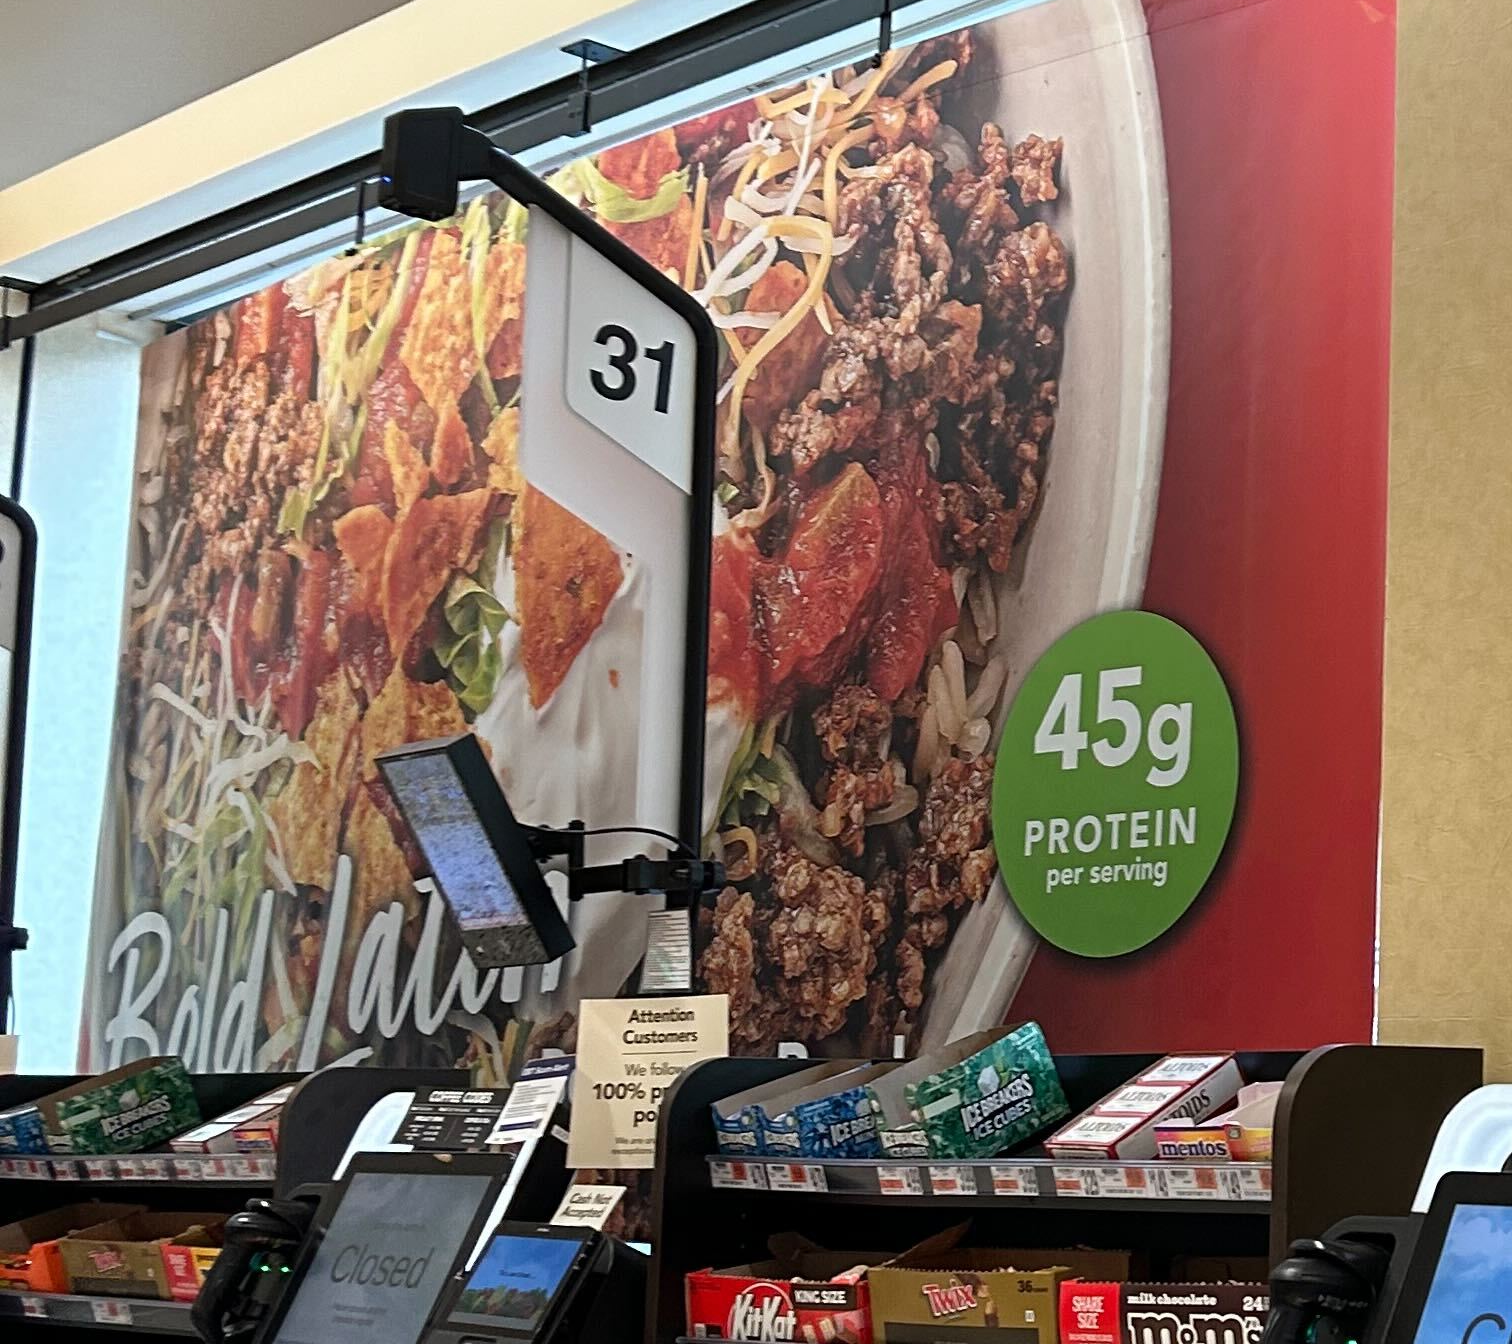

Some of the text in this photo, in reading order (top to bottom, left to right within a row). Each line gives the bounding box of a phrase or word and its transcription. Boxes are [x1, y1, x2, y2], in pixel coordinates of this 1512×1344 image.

[589, 324, 676, 414] 31
[1034, 666, 1193, 788] 45g
[1024, 807, 1197, 856] PROTEIN
[1046, 856, 1168, 893] per serving
[105, 889, 275, 1073] Bold
[627, 1008, 695, 1024] Attention
[622, 1029, 699, 1045] Customers
[625, 1064, 647, 1077] We
[593, 1083, 646, 1100] 100%
[994, 1099, 1032, 1129] CUBES
[1160, 1140, 1228, 1156] mentos
[331, 1244, 435, 1288] Closed
[1017, 1279, 1033, 1293] 36
[794, 1290, 847, 1305] KING SIZE
[1072, 1296, 1104, 1313] SHARE
[1127, 1293, 1217, 1306] milk chocolate
[1242, 1296, 1263, 1312] 24
[730, 1292, 797, 1343] KitKat
[1077, 1313, 1099, 1329] SIZE
